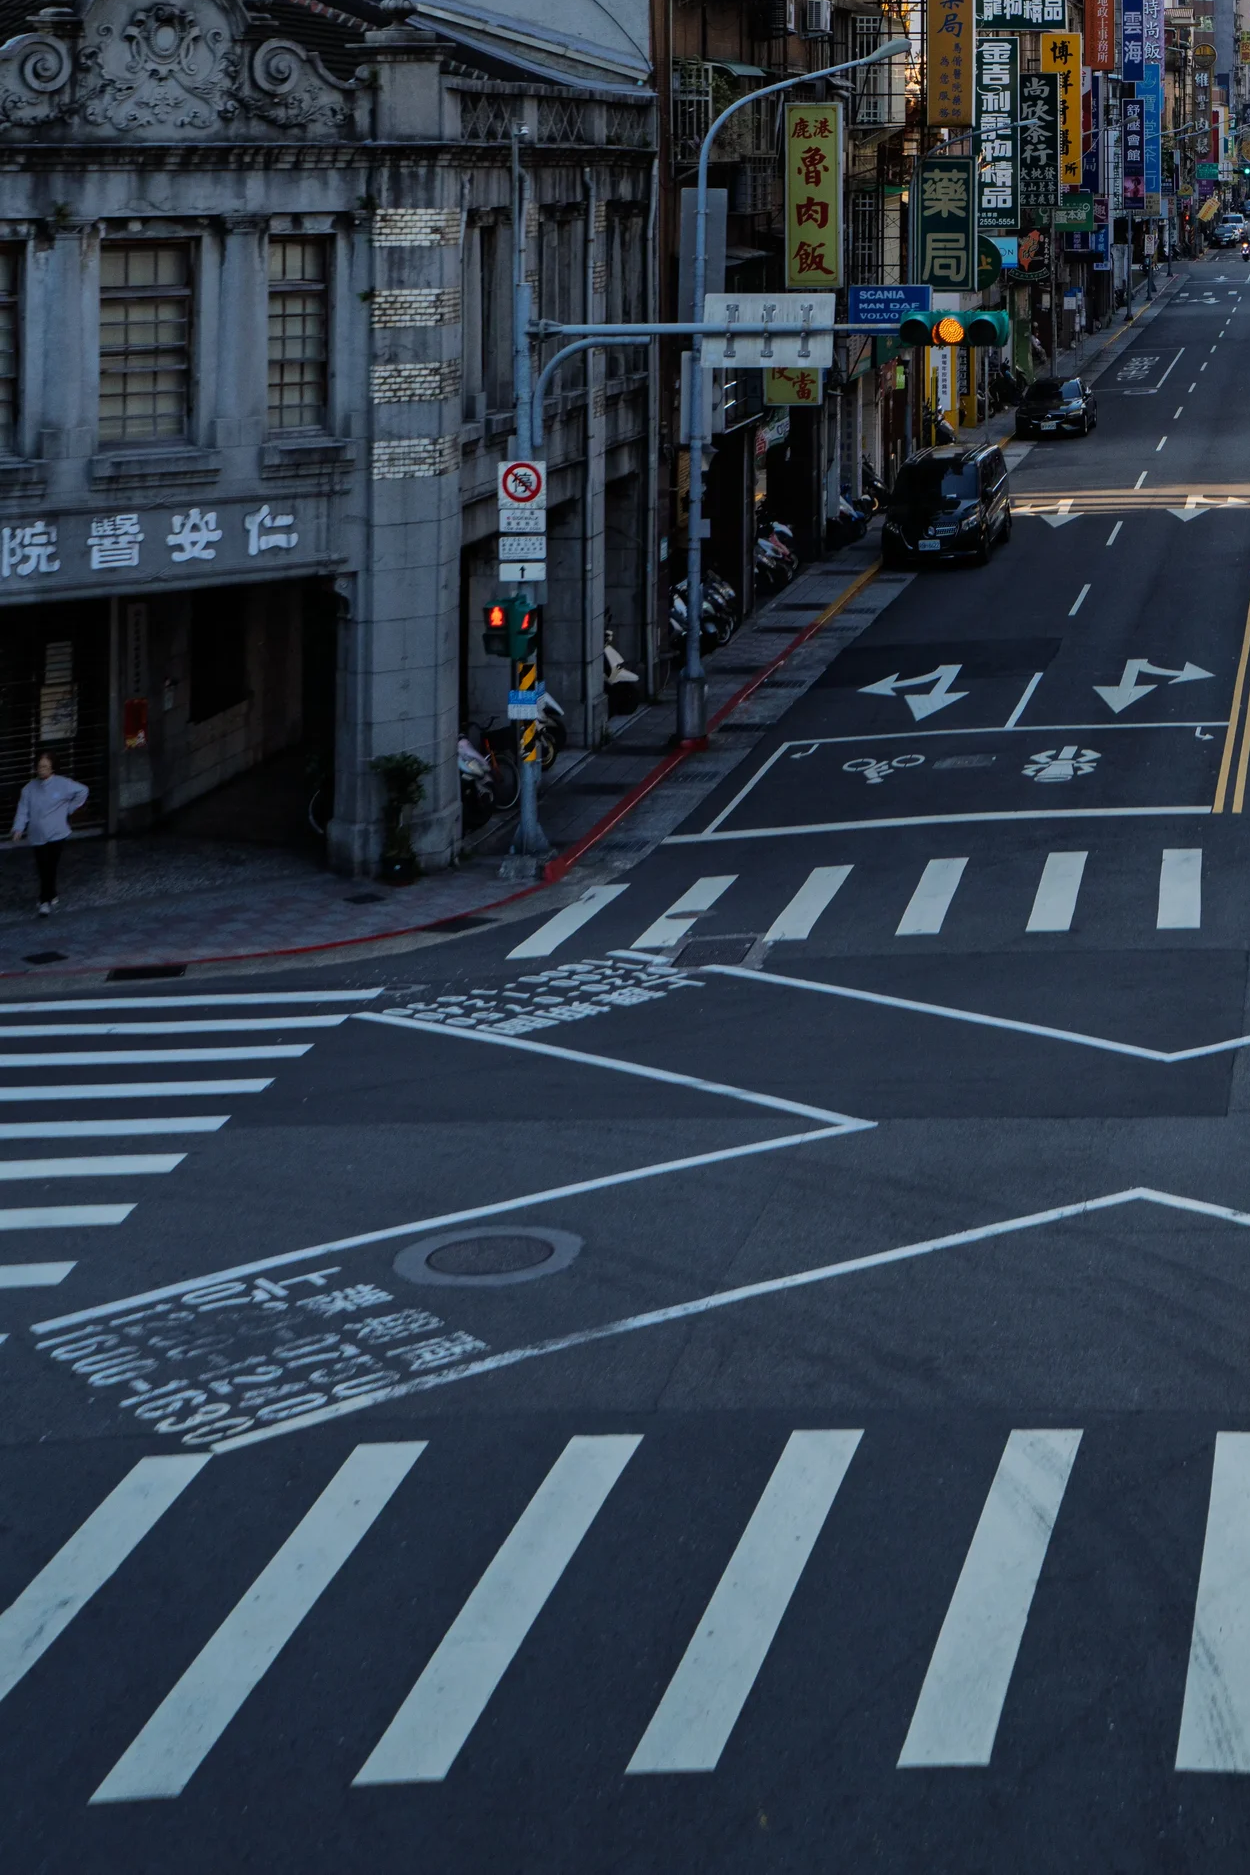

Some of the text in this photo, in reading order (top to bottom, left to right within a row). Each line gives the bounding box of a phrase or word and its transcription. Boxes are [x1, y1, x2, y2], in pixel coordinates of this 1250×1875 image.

[1124, 11, 1142, 64] 雲海
[791, 117, 834, 139] 鹿港
[792, 146, 835, 276] 魯肉飯
[922, 168, 968, 282] 藥局
[859, 290, 905, 299] SCANIA
